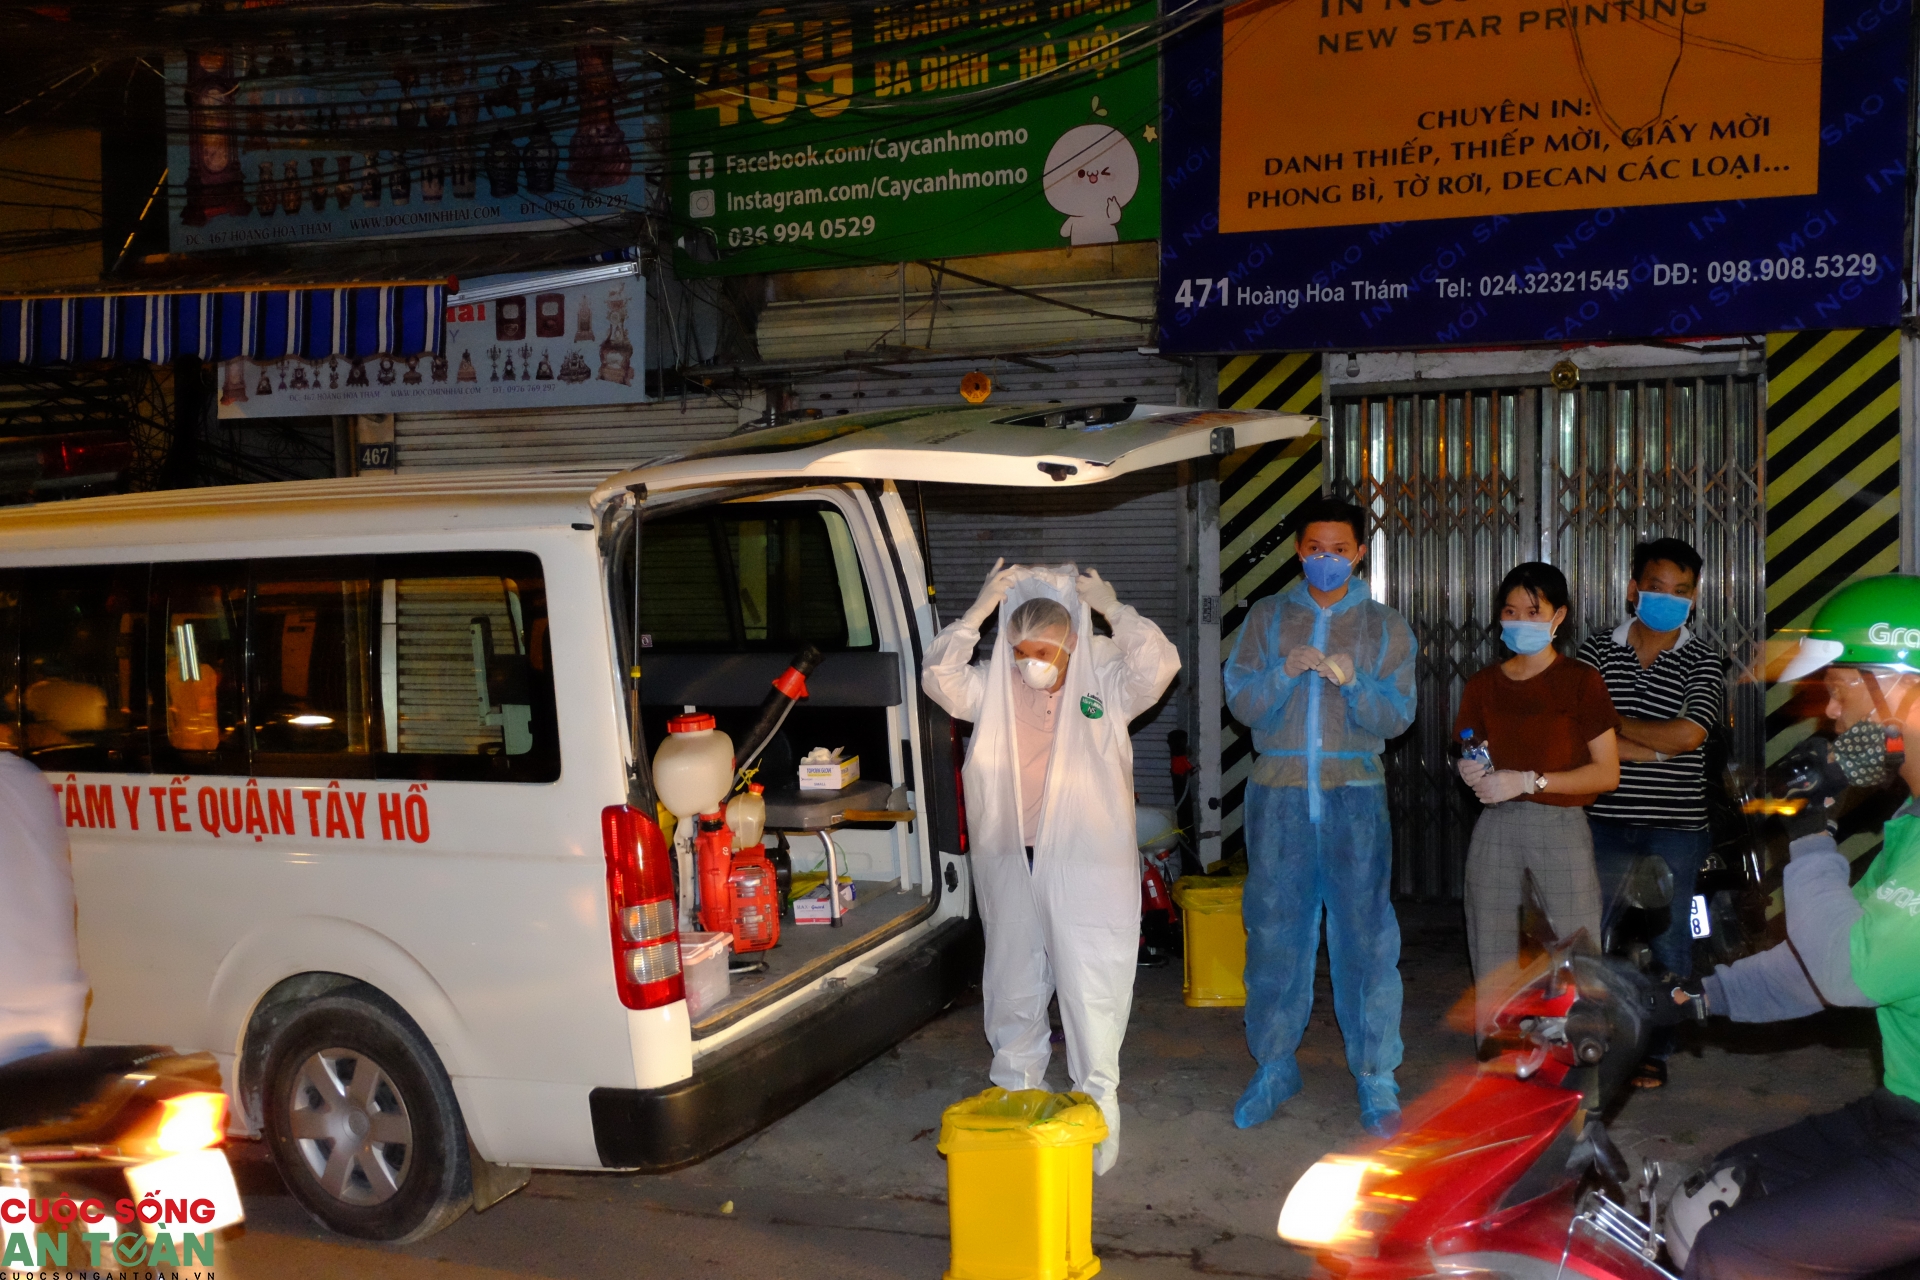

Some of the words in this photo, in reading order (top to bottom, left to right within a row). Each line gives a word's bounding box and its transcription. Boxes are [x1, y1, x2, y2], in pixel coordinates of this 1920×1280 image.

[1318, 27, 1398, 54] NEW
[1412, 15, 1501, 44] STAR
[1519, 0, 1706, 33] PRINTING
[874, 60, 912, 97] BA
[1019, 31, 1058, 80] HÀ
[1068, 25, 1120, 79] NỘI
[1418, 98, 1539, 130] CHUYÊN
[1552, 98, 1591, 118] IN:
[726, 128, 1028, 174] Facebook.com/Caycanhmomo
[1265, 152, 1343, 176] DANH
[1353, 137, 1440, 168] THIẾP,
[1451, 128, 1535, 160] THIẾP
[1544, 126, 1610, 153] MỜI,
[1622, 115, 1698, 147] GIẤY
[1710, 112, 1769, 140] MỜI
[727, 167, 1028, 213] Instagram.com/Caycanhmomo
[1248, 185, 1341, 209] PHONG
[1352, 177, 1384, 203] BÌ,
[1394, 173, 1430, 198] TỜ
[1438, 173, 1491, 196] RƠI,
[1503, 165, 1606, 190] DECAN
[1618, 155, 1680, 182] CÁC
[273, 225, 296, 237] HOA
[545, 199, 575, 212] 0976
[579, 196, 603, 209] 769
[728, 226, 768, 247] 036
[774, 221, 814, 243] 994
[820, 215, 875, 239] 0529
[1174, 278, 1229, 308] 471
[1238, 286, 1299, 308] Hoàng
[1306, 282, 1344, 302] Hoa
[1351, 279, 1408, 300] Thám
[1435, 278, 1472, 298] Tel:
[1480, 269, 1629, 297] 024.32321545
[1653, 262, 1697, 286] DĐ:
[1707, 253, 1877, 283] 098.908.5329
[362, 446, 390, 466] 467
[1868, 622, 1920, 649] Gra
[121, 785, 139, 831] Y
[149, 775, 192, 832] TẾ
[197, 778, 296, 842] QUẬN
[302, 780, 367, 840] TÂY
[378, 782, 430, 844] HỒ
